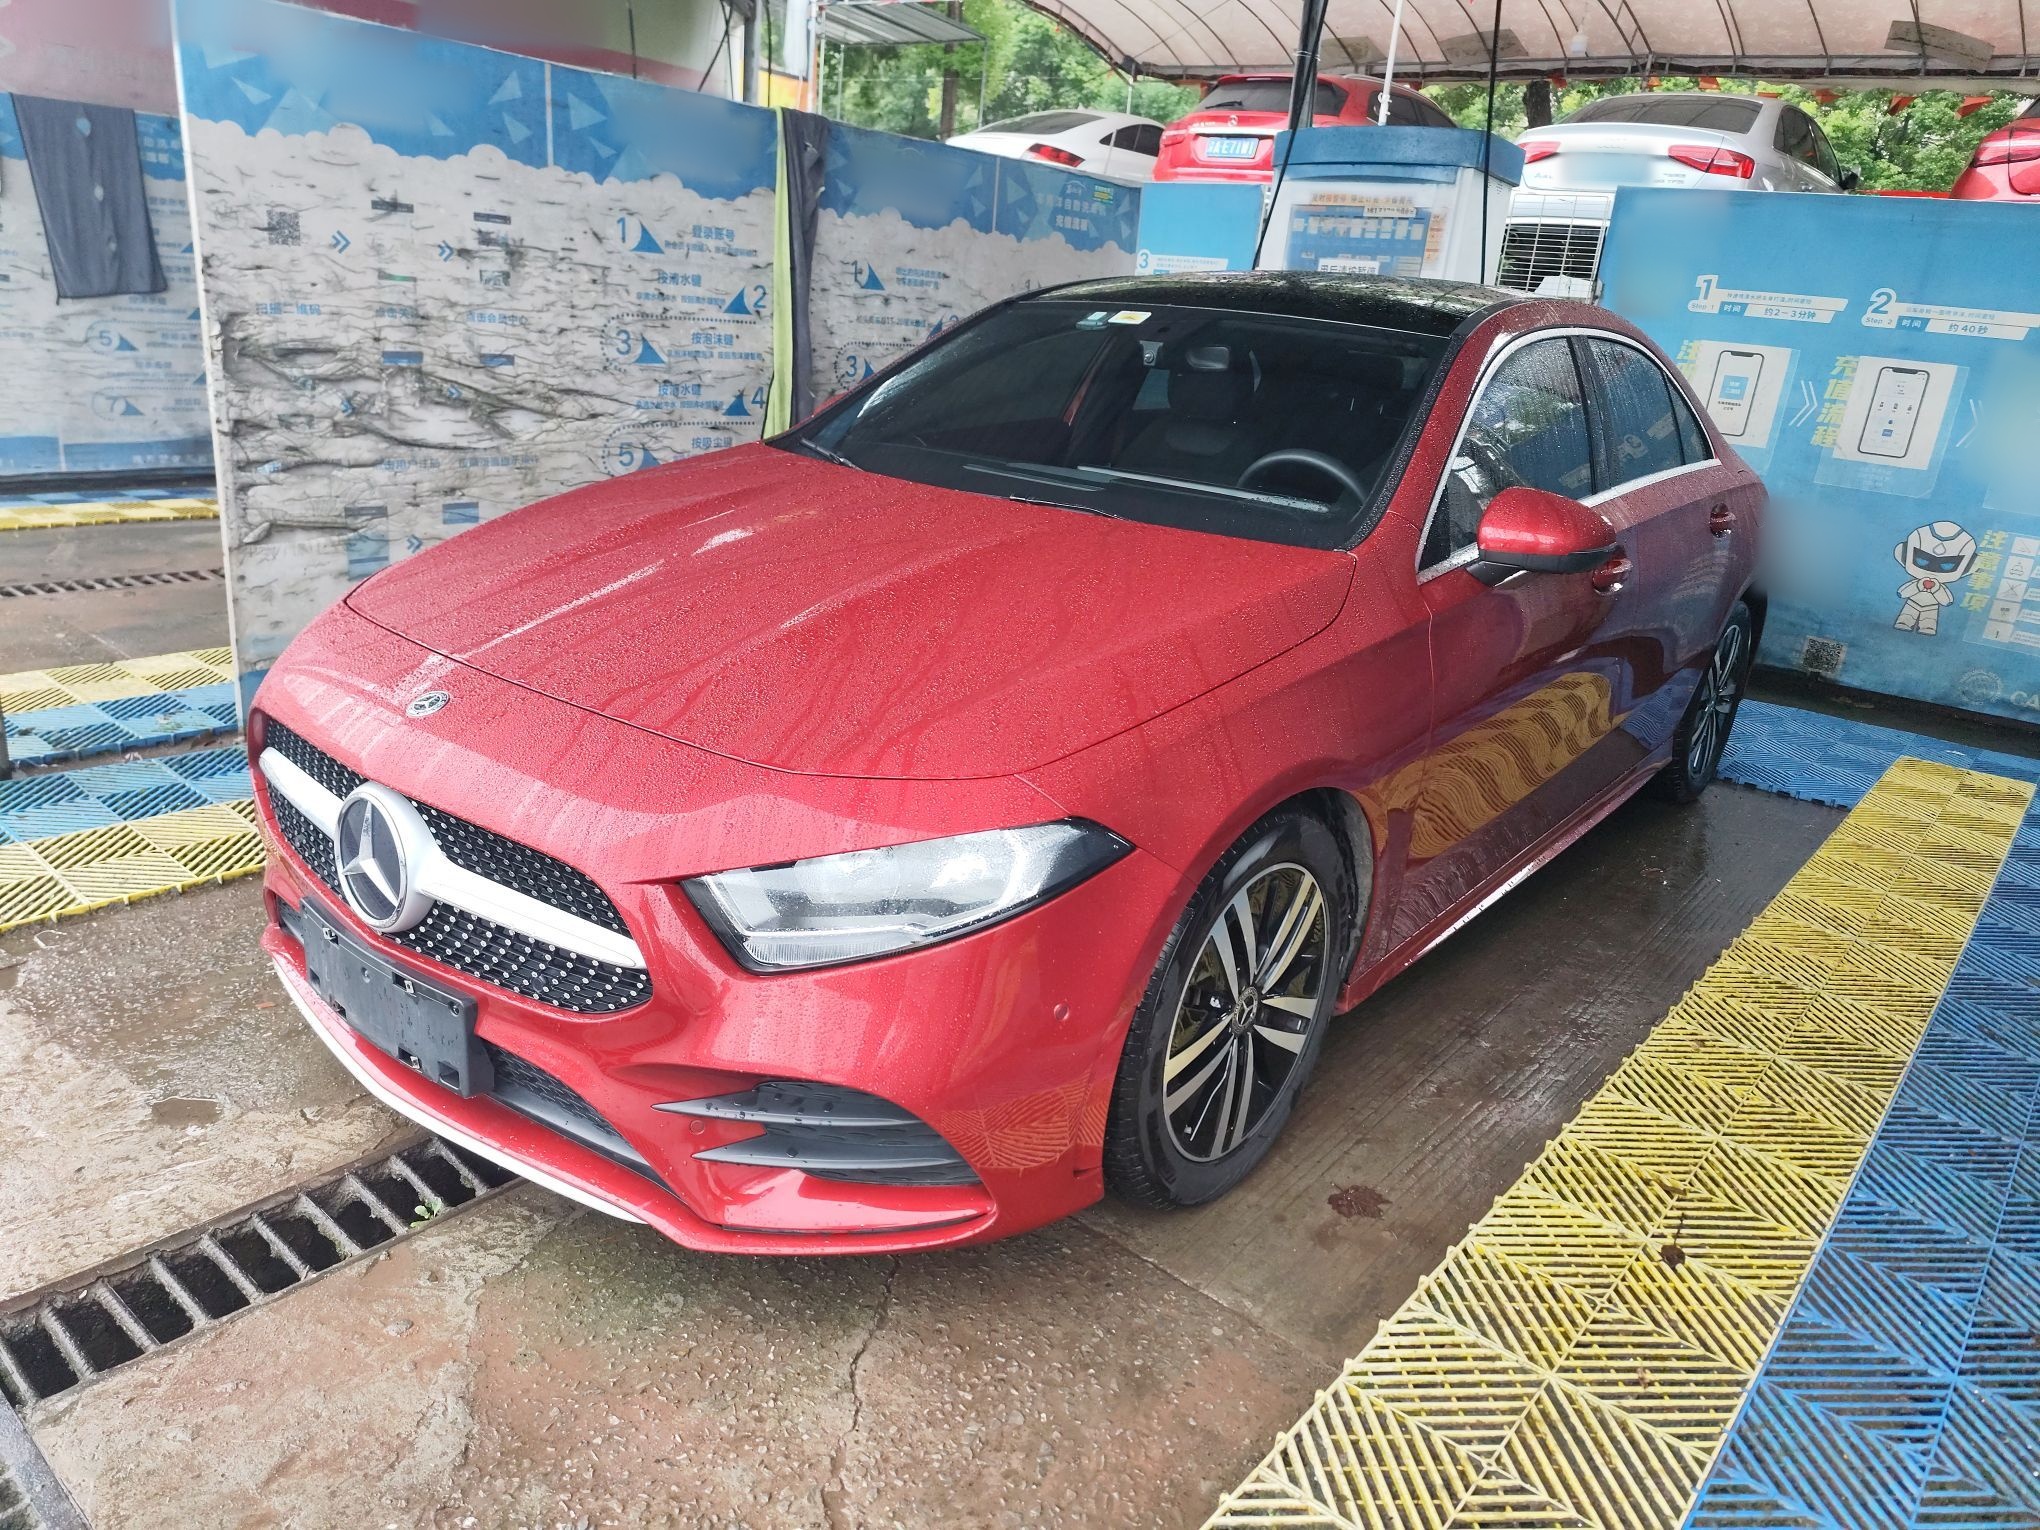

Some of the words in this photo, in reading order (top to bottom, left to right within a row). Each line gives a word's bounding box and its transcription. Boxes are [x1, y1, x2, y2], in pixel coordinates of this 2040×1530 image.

[616, 217, 626, 243] 1
[1140, 252, 1149, 268] 3
[657, 271, 702, 287] 按清水键
[1702, 278, 1713, 301] 1
[753, 284, 767, 308] 2
[1870, 291, 1893, 315] 2
[1723, 304, 1742, 314] 时间
[1865, 316, 1883, 325] Step
[1901, 319, 1922, 329] 时间
[99, 330, 112, 347] 5
[616, 329, 631, 355] 3
[691, 332, 734, 346] 按泡沫键
[846, 355, 857, 377] 3
[751, 386, 765, 409] 4
[619, 441, 634, 467] 5
